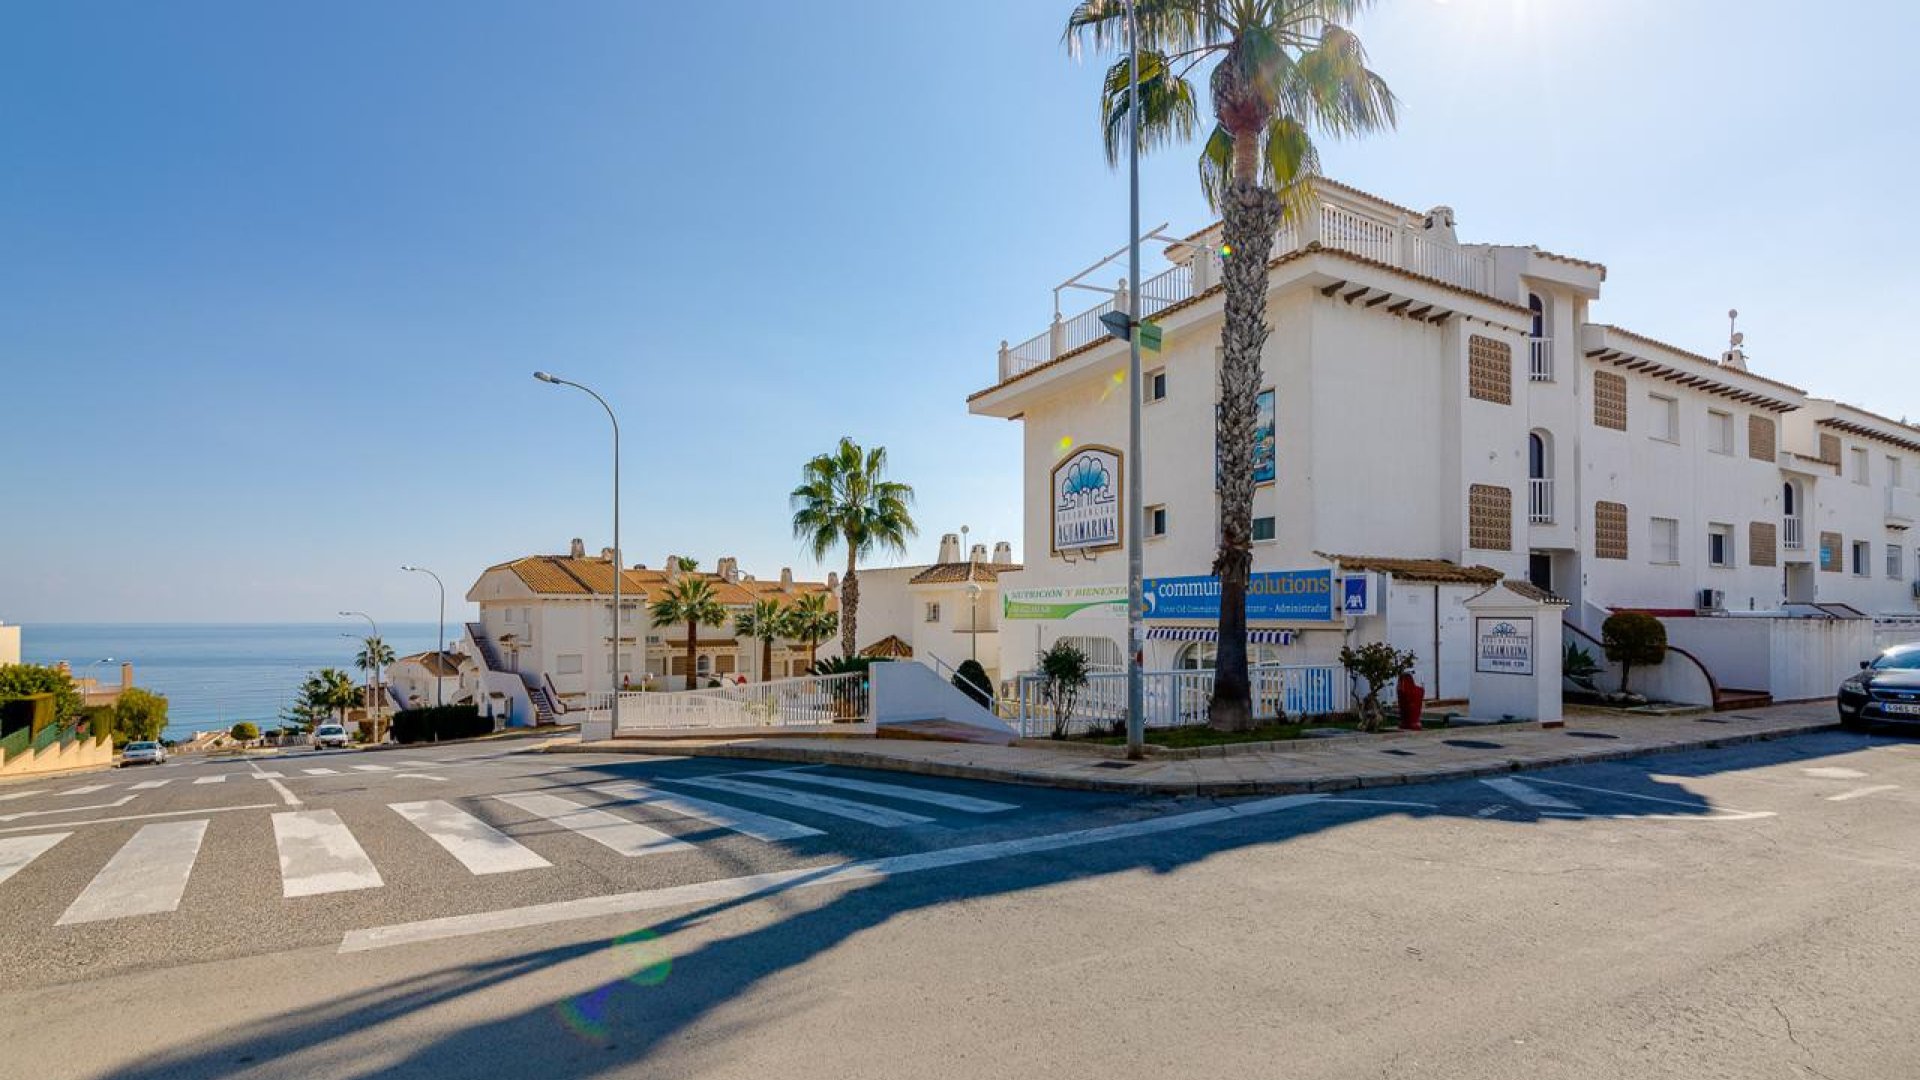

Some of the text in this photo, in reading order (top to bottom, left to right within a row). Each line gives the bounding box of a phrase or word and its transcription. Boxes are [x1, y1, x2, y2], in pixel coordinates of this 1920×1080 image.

[1074, 585, 1128, 597] BIENESTA
[1158, 581, 1222, 597] commun
[1345, 595, 1363, 608] AXA
